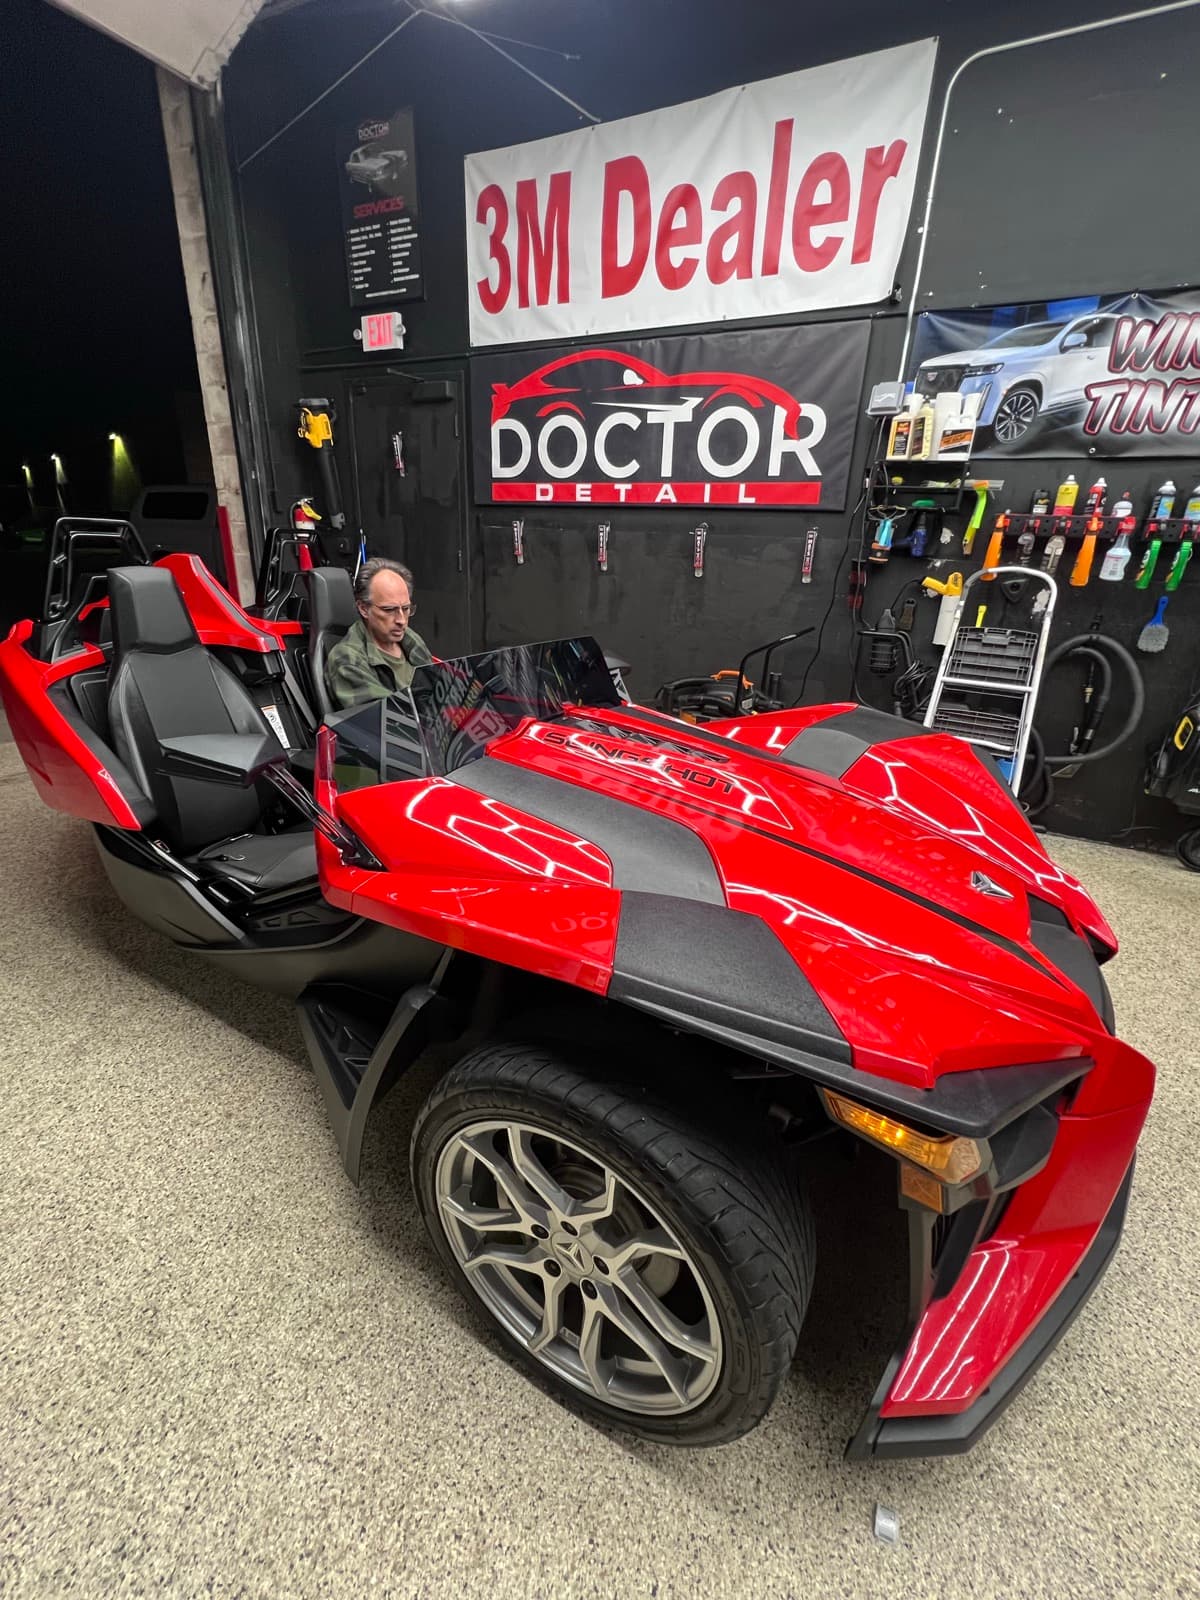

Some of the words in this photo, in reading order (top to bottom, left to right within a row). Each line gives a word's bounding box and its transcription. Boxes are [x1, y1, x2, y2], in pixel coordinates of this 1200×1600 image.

[353, 196, 404, 219] SERVICES
[476, 171, 572, 314] 3M
[601, 118, 908, 299] Dealer
[367, 314, 393, 348] EXIT
[491, 399, 827, 479] DOCTOR
[535, 483, 756, 504] DETAIL
